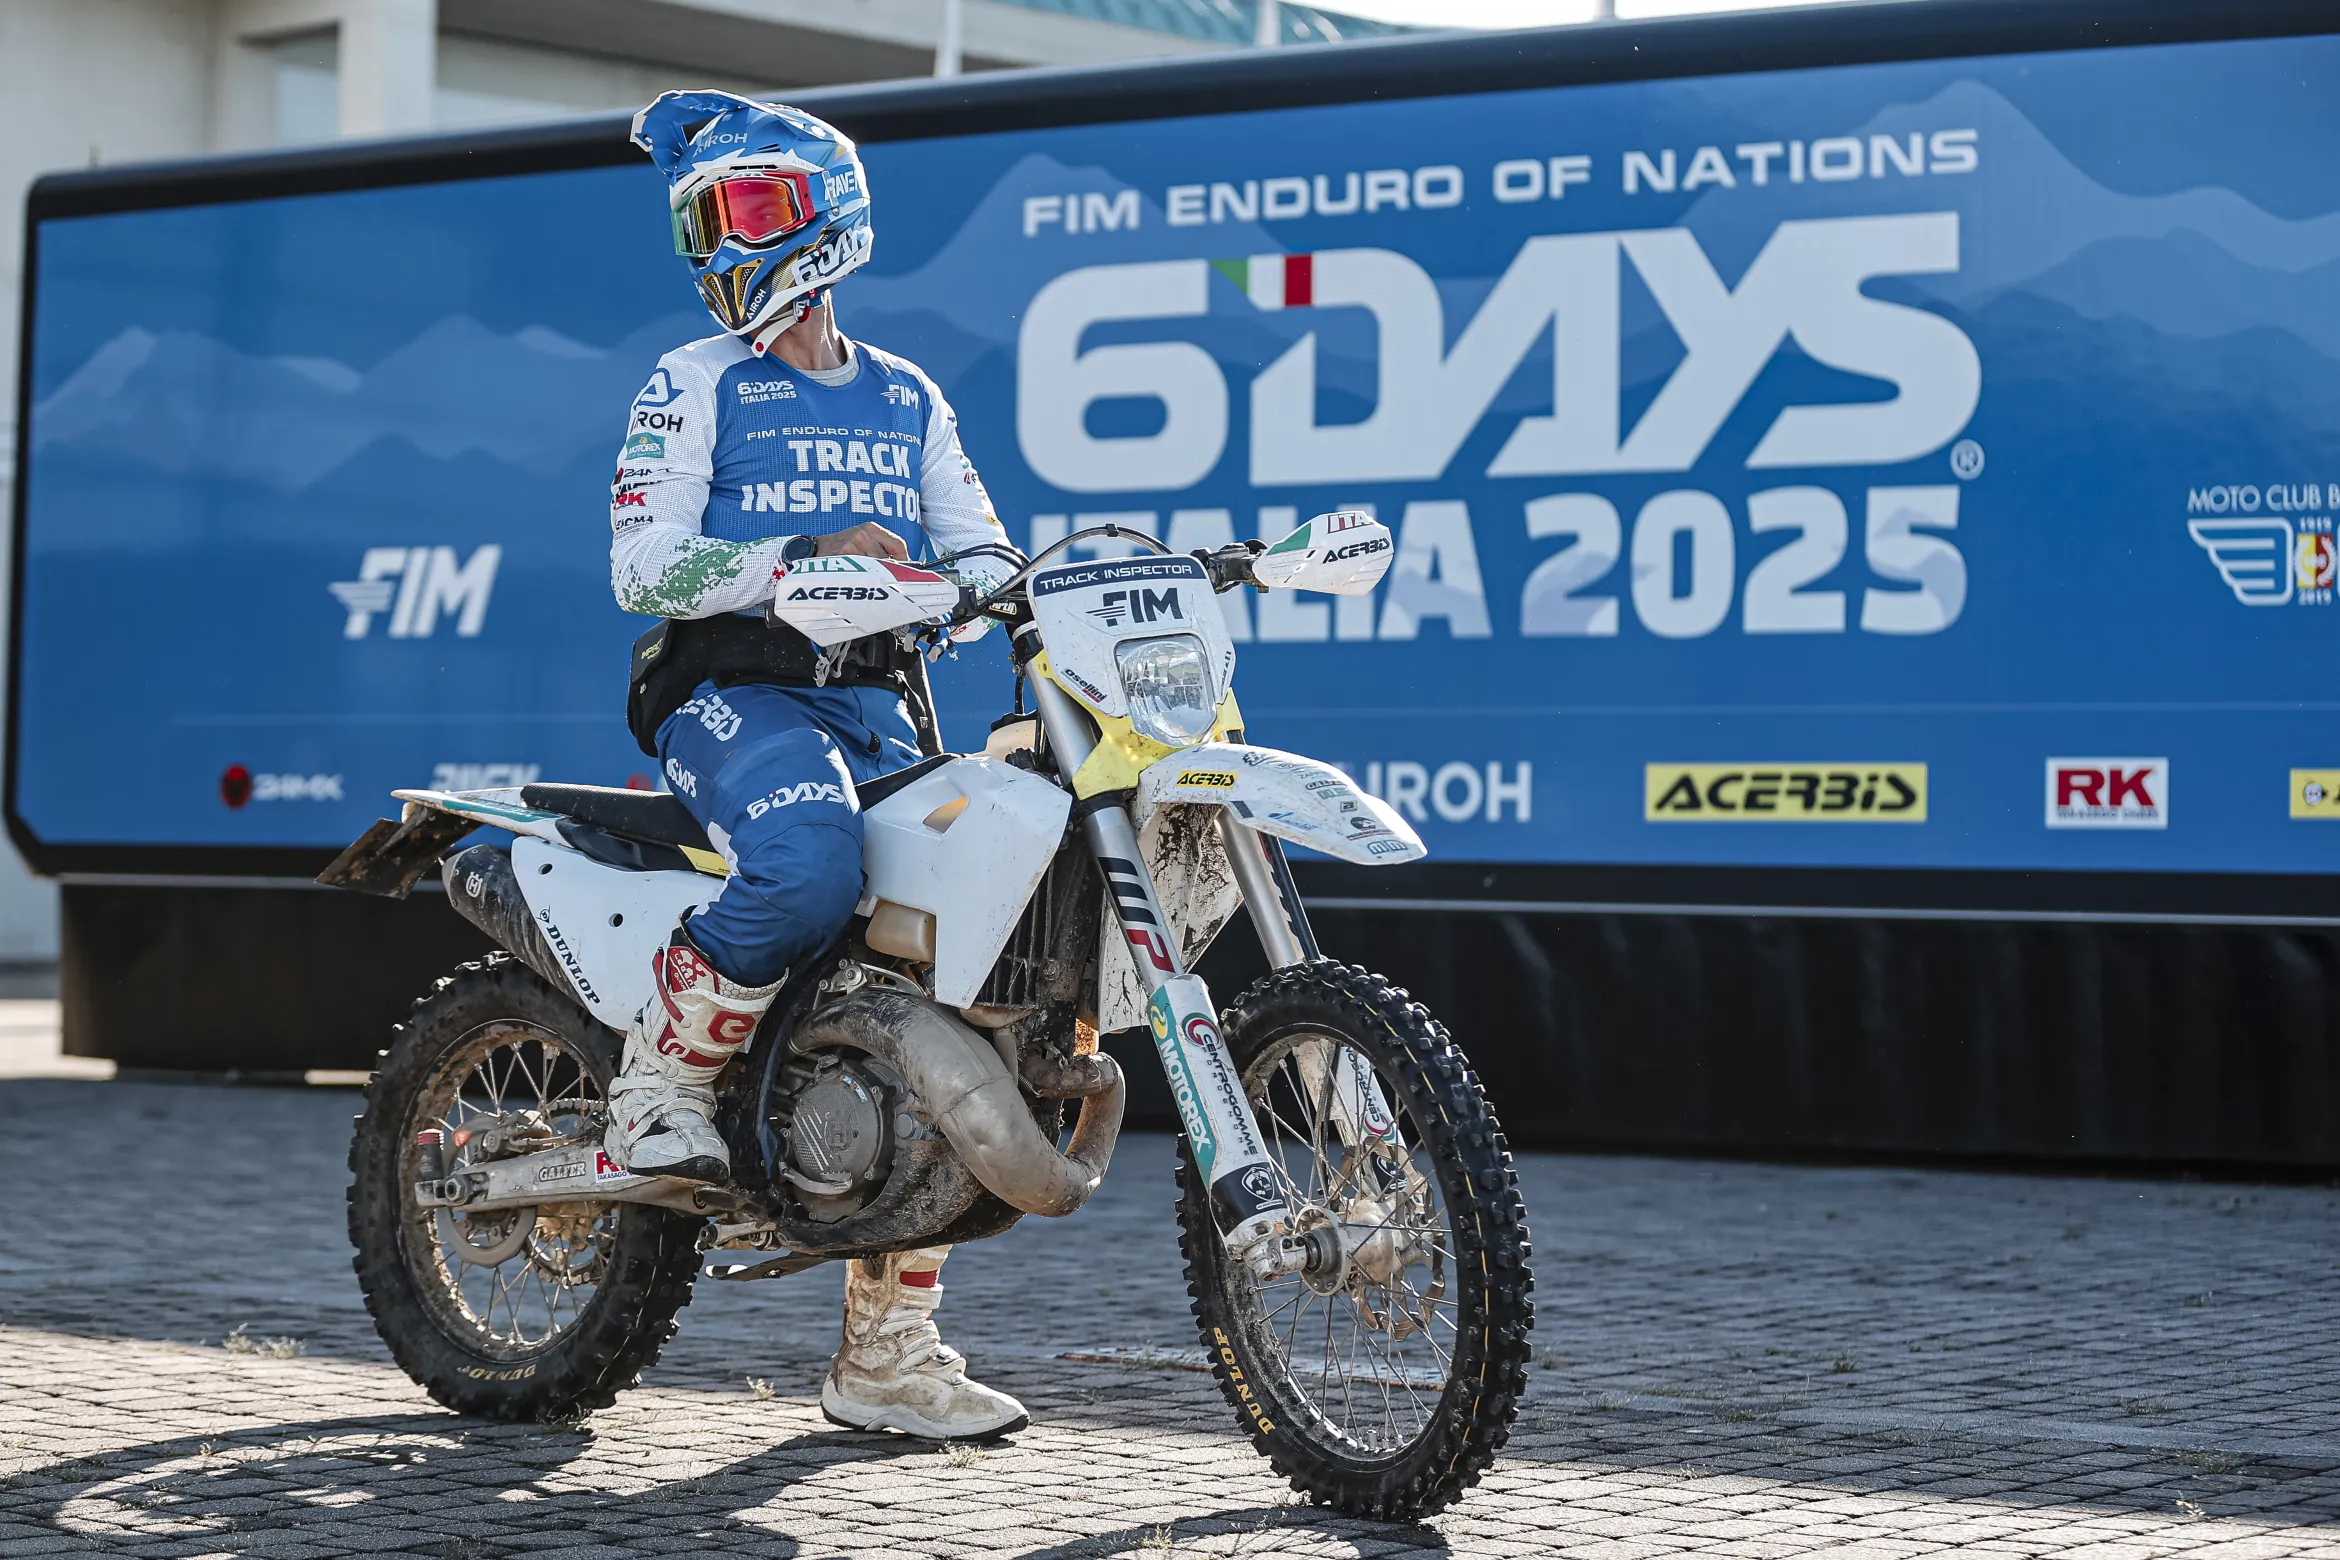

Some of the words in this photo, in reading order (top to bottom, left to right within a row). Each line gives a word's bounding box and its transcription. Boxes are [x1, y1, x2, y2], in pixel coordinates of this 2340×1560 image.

[1023, 190, 1140, 237] FIM
[1166, 165, 1464, 227] ENDURO
[1492, 154, 1592, 203] OF
[1622, 128, 1978, 195] NATIONS
[745, 289, 767, 320] AIROH
[1016, 210, 1982, 492] 6DAYS
[737, 380, 795, 395] 6DAYS
[740, 393, 771, 405] ITALIA
[771, 390, 797, 400] 2025
[880, 384, 919, 410] FIM
[747, 429, 776, 441] FIM
[782, 426, 849, 436] ENDURO
[854, 429, 873, 437] OF
[787, 439, 911, 479] TRACK
[2187, 484, 2261, 513] MOTO
[2265, 483, 2322, 512] CLUB
[1329, 513, 1371, 532] ITA
[798, 556, 849, 573] ITA
[1040, 570, 1099, 590] TRACK
[1104, 564, 1193, 579] INSPECTOR
[1520, 484, 1968, 639] 2025
[328, 543, 503, 640] FIM
[1085, 587, 1184, 627] FIM
[746, 782, 847, 820] 6DAYS
[1332, 761, 1532, 823] IROH
[2057, 768, 2156, 807] RK
[546, 924, 601, 1005] DUNLOP
[1159, 1038, 1211, 1154] MOTOREX
[1203, 1033, 1259, 1156] CENTROGOMME
[539, 1162, 586, 1181] GALFER
[596, 1151, 626, 1175] R
[597, 1171, 627, 1181] TAKASAGO
[1213, 1327, 1276, 1435] DUNLOP
